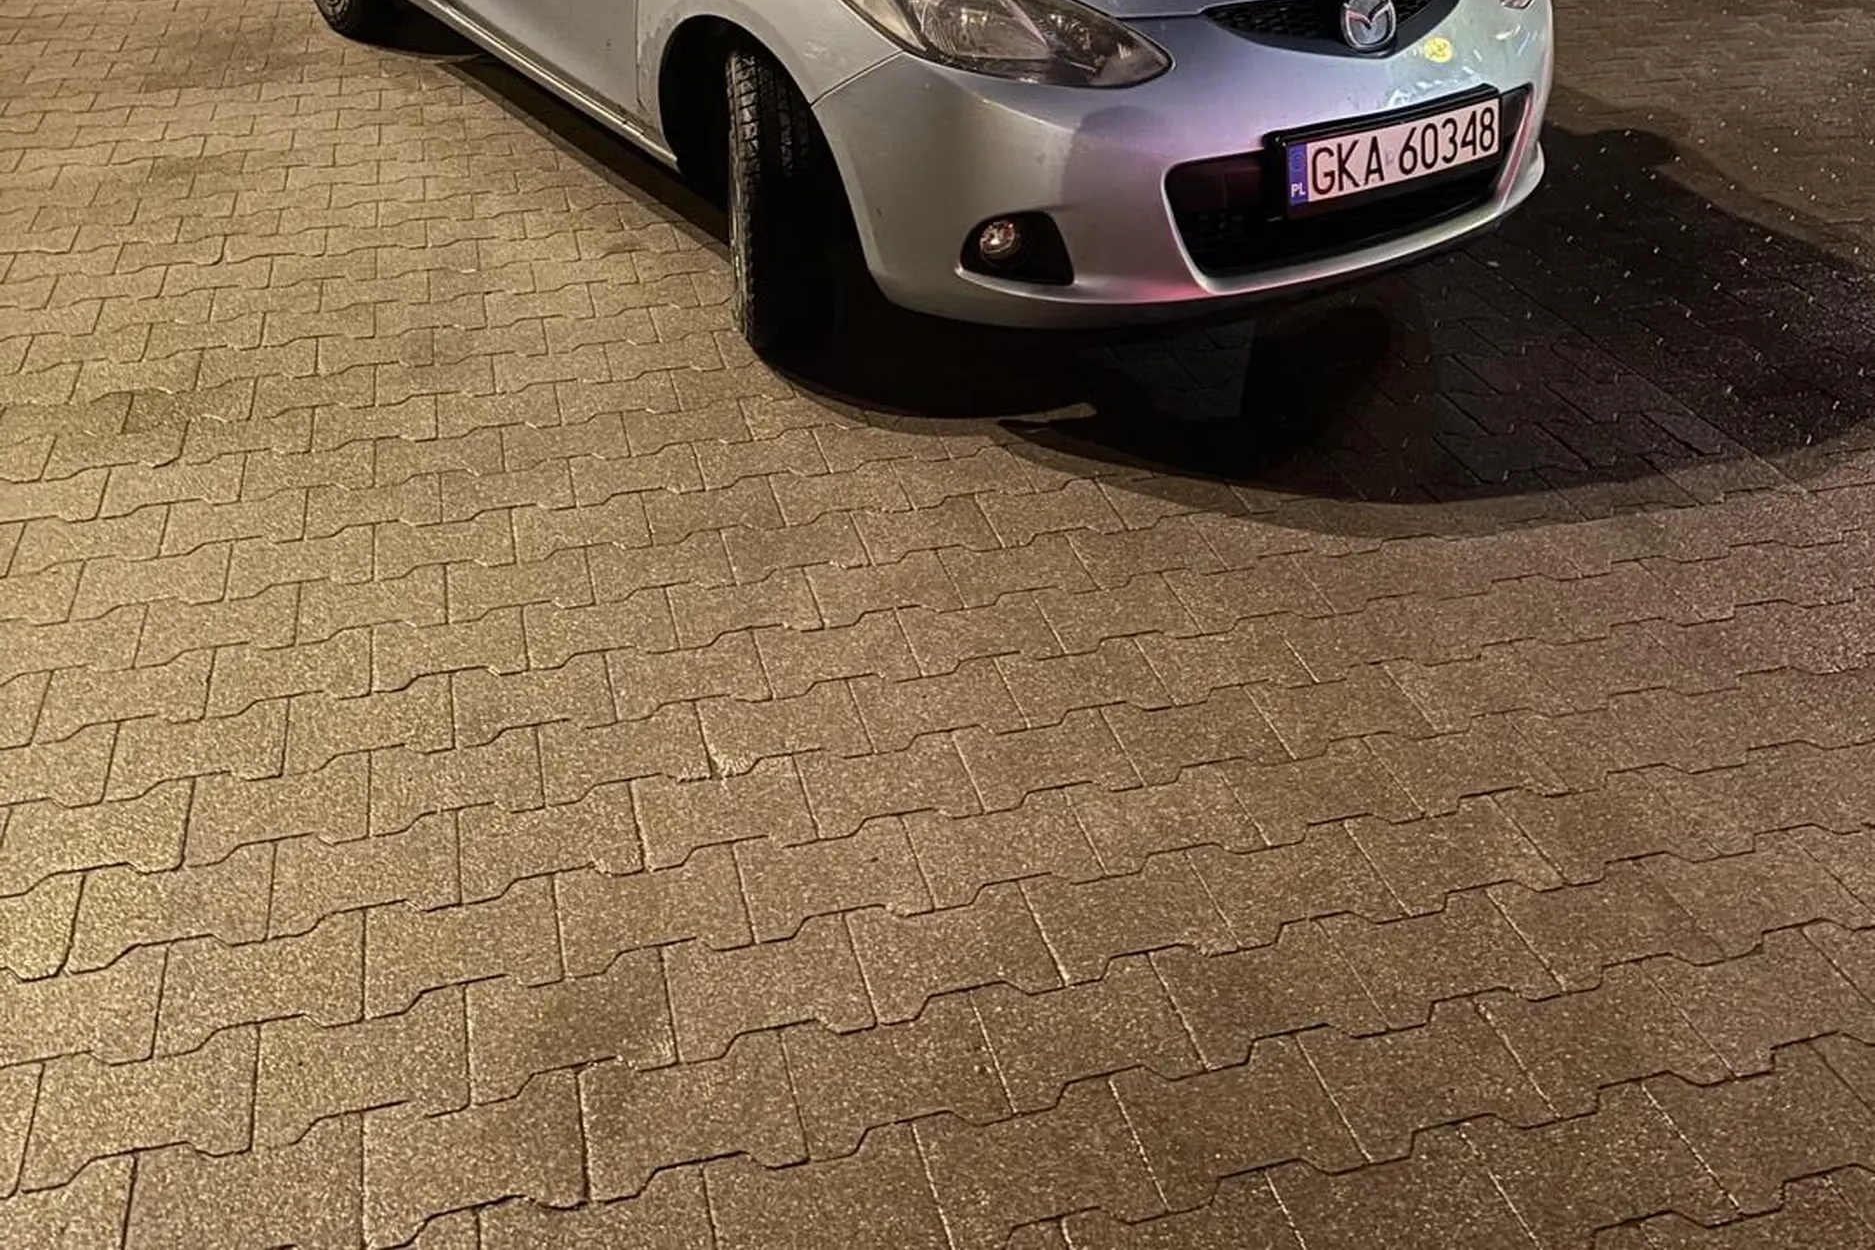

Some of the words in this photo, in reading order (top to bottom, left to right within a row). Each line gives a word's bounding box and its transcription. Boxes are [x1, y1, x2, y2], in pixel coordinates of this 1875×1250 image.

[1311, 136, 1385, 195] GKA
[1399, 107, 1495, 175] 60348
[1291, 183, 1306, 197] PL
